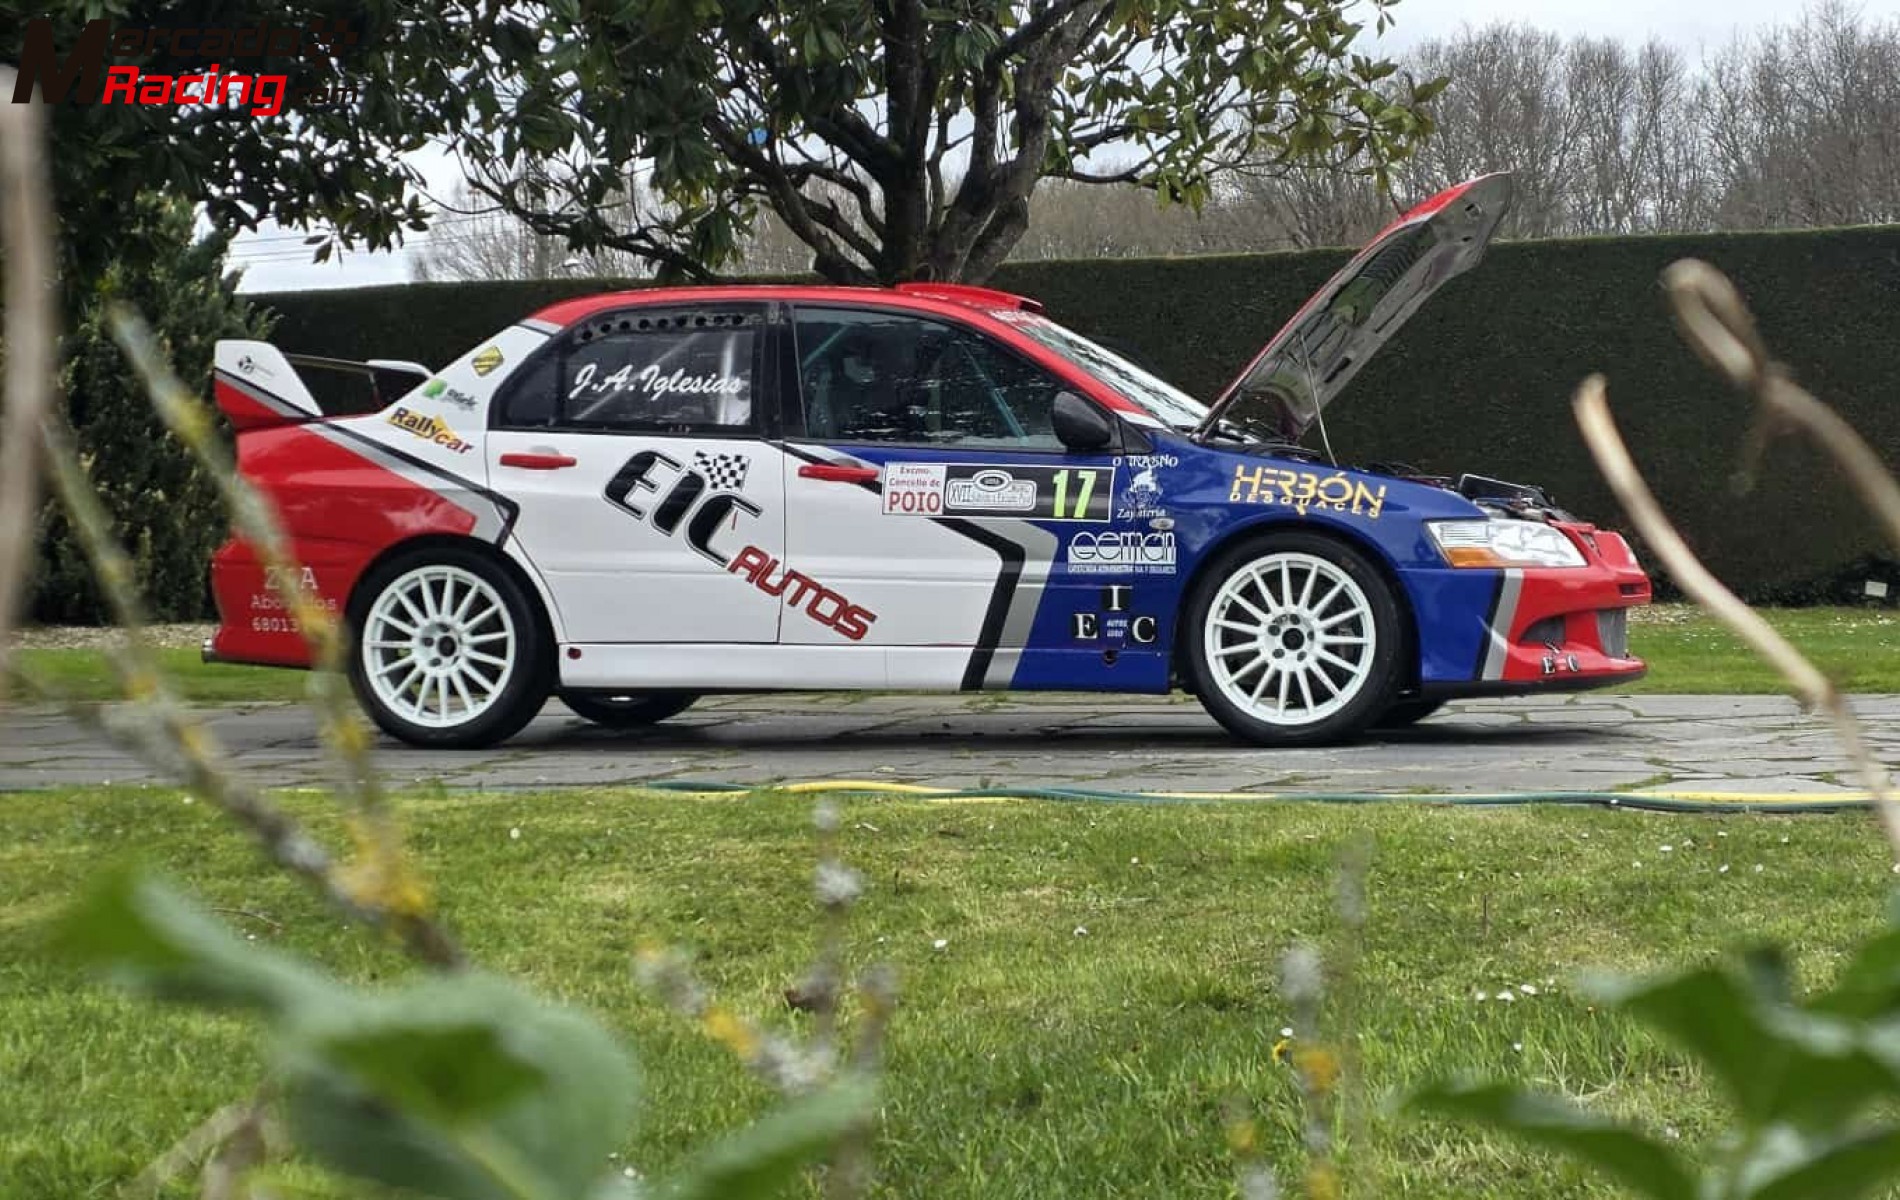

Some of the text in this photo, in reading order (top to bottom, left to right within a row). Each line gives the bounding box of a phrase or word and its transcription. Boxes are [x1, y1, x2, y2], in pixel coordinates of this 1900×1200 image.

[391, 406, 474, 455] Rallycar
[888, 490, 941, 513] POIO
[1052, 469, 1097, 518] 17
[1232, 464, 1388, 516] HERBÓN
[727, 545, 878, 641] AUTOS
[1073, 613, 1156, 643] E C
